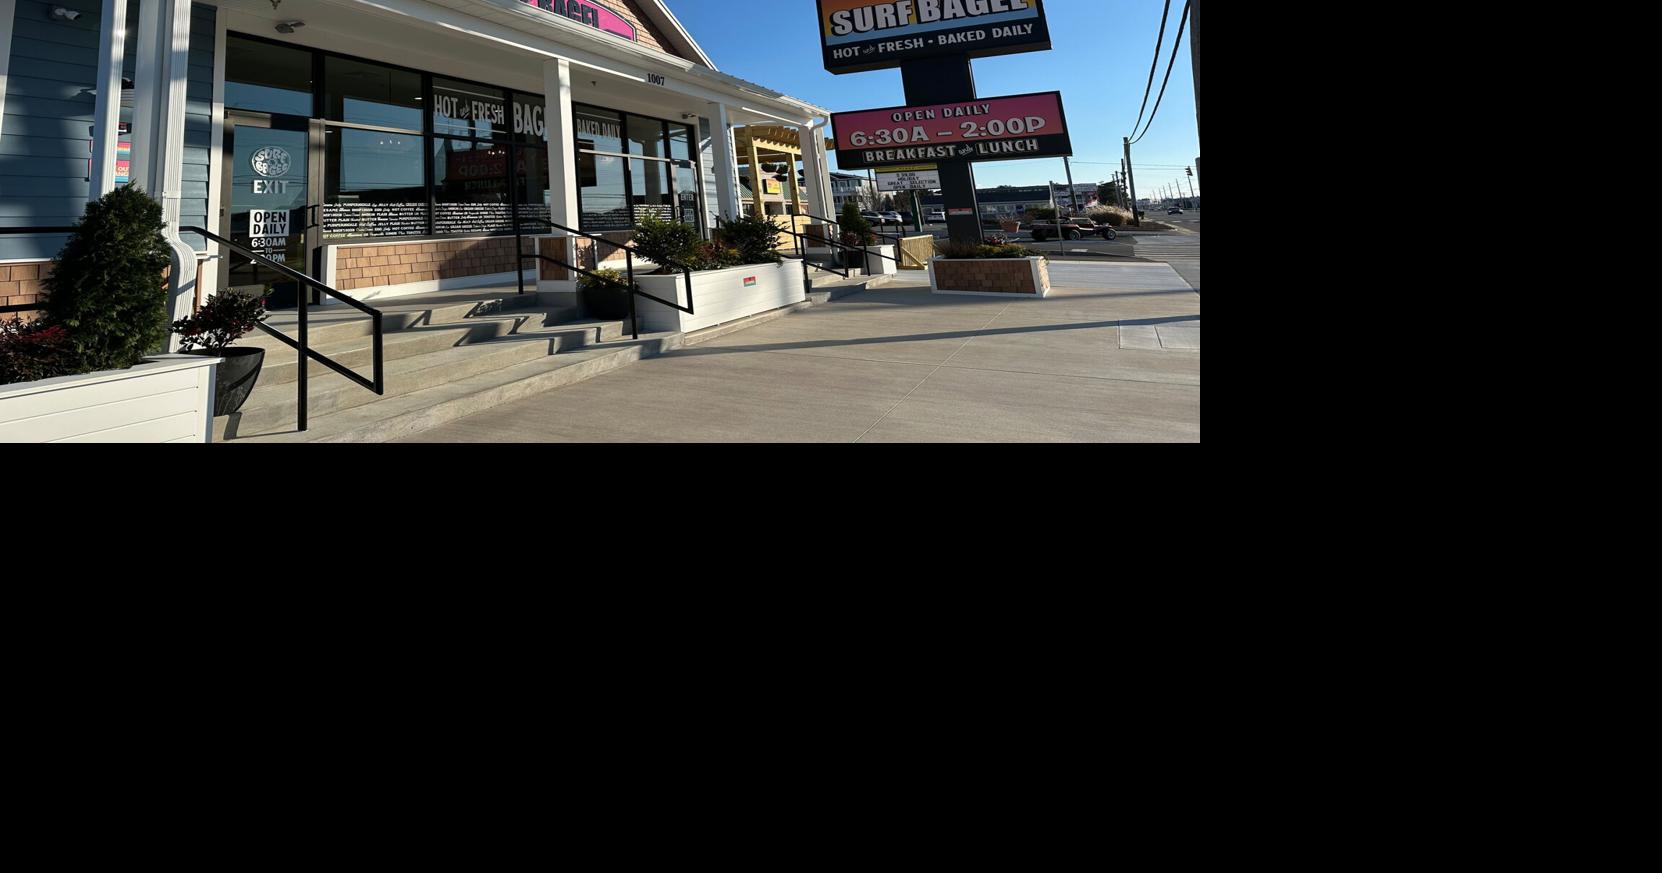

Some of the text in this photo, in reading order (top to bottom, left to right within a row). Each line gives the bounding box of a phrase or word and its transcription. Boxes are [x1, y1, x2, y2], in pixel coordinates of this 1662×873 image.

[831, 3, 914, 35] SURF
[833, 46, 860, 59] HOT
[878, 37, 924, 53] FRESH
[938, 30, 986, 45] BAKED
[992, 23, 1033, 38] DAILY
[647, 73, 664, 86] 1007
[433, 94, 458, 118] HOT
[472, 100, 505, 125] FRESH
[512, 101, 545, 137] BAG
[891, 103, 991, 122] OPEN DAILY
[577, 119, 621, 140] BAKED DAILY
[850, 126, 929, 147] 6:30A
[960, 115, 1046, 138] 2:00P
[865, 144, 957, 163] BREAKFAST
[978, 138, 1039, 155] LUNCH
[253, 180, 288, 193] EXIT
[252, 211, 287, 223] OPEN
[253, 223, 287, 235] DAILY
[251, 237, 286, 248] 6:30AM
